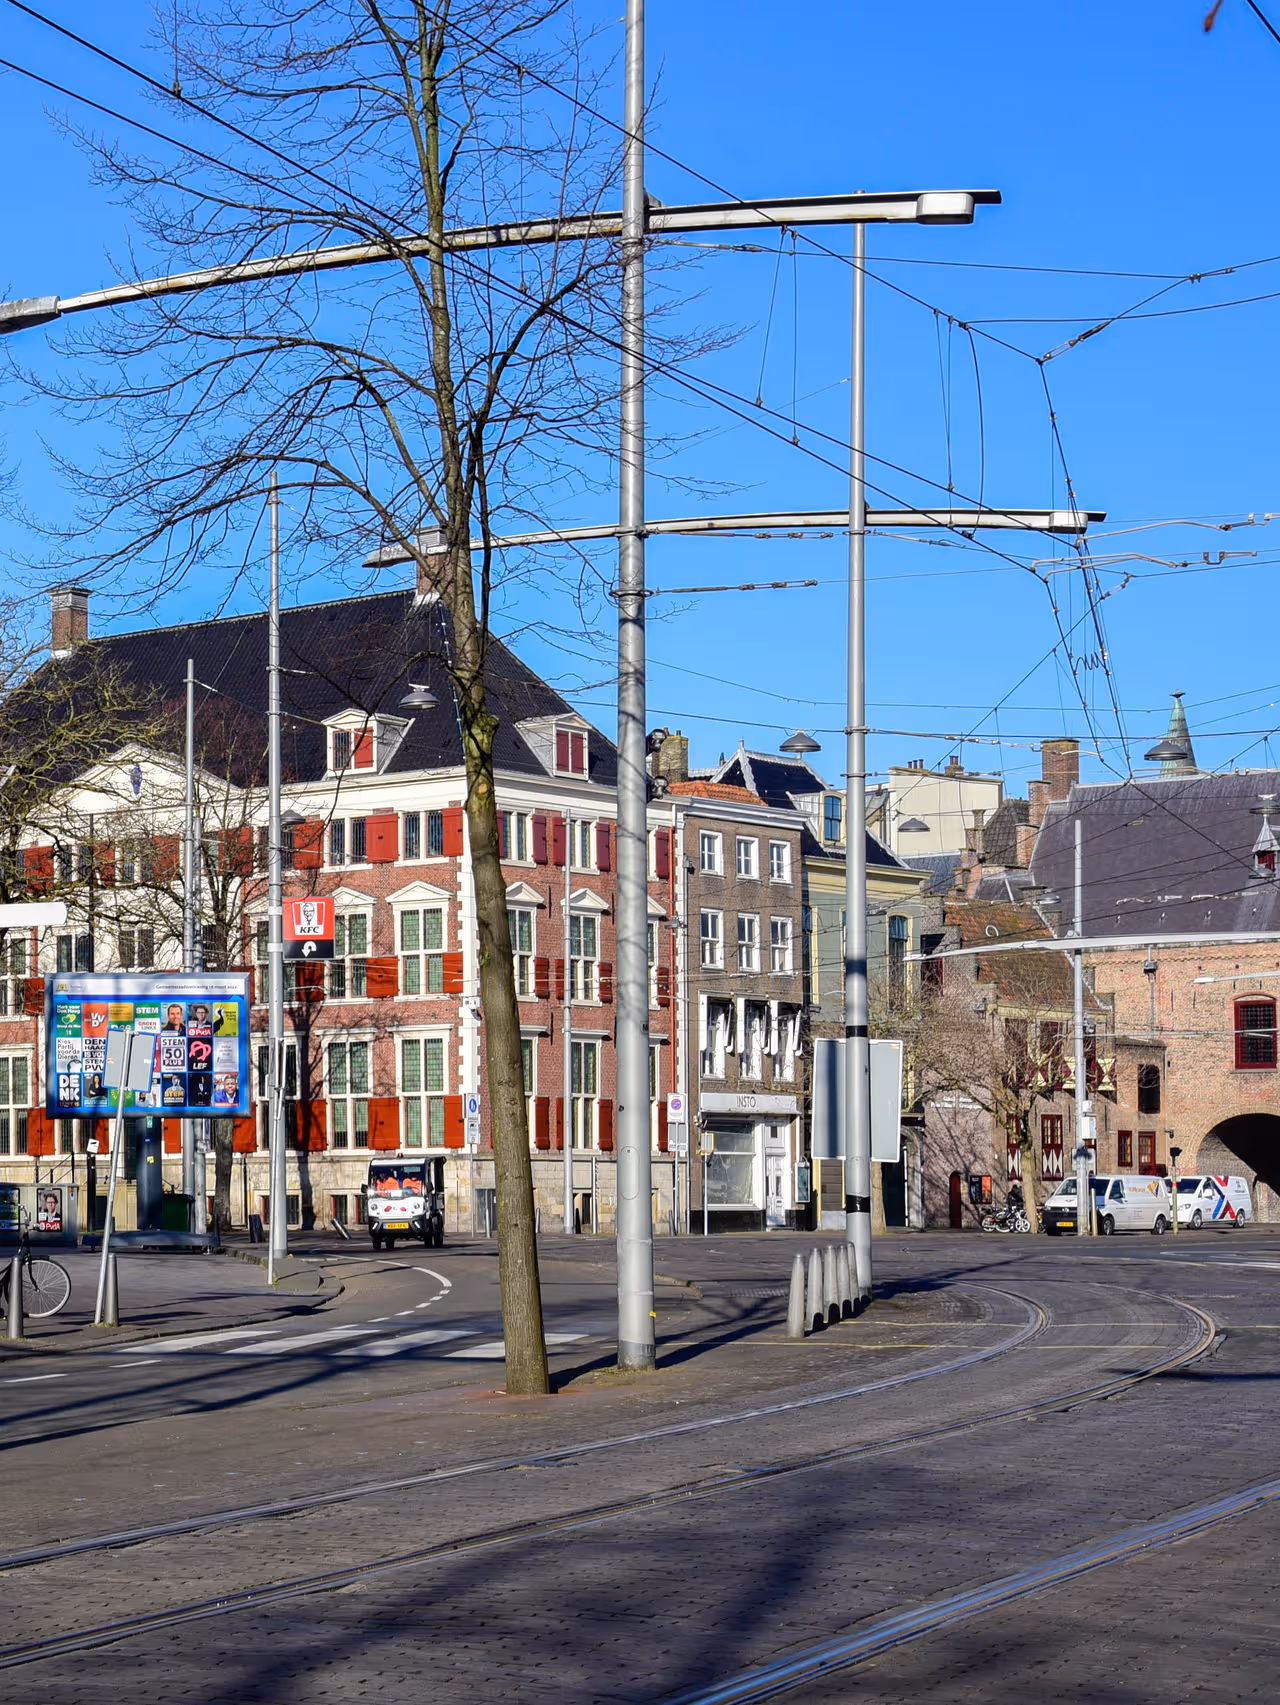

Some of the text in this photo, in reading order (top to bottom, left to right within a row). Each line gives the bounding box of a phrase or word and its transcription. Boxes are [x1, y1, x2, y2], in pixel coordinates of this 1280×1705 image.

[299, 926, 319, 934] KFC
[135, 1006, 159, 1014] STEM
[162, 1038, 186, 1046] STEM
[165, 1048, 183, 1059] 50
[192, 1062, 208, 1070] LEF
[59, 1074, 80, 1088] DE
[59, 1087, 80, 1101] NK
